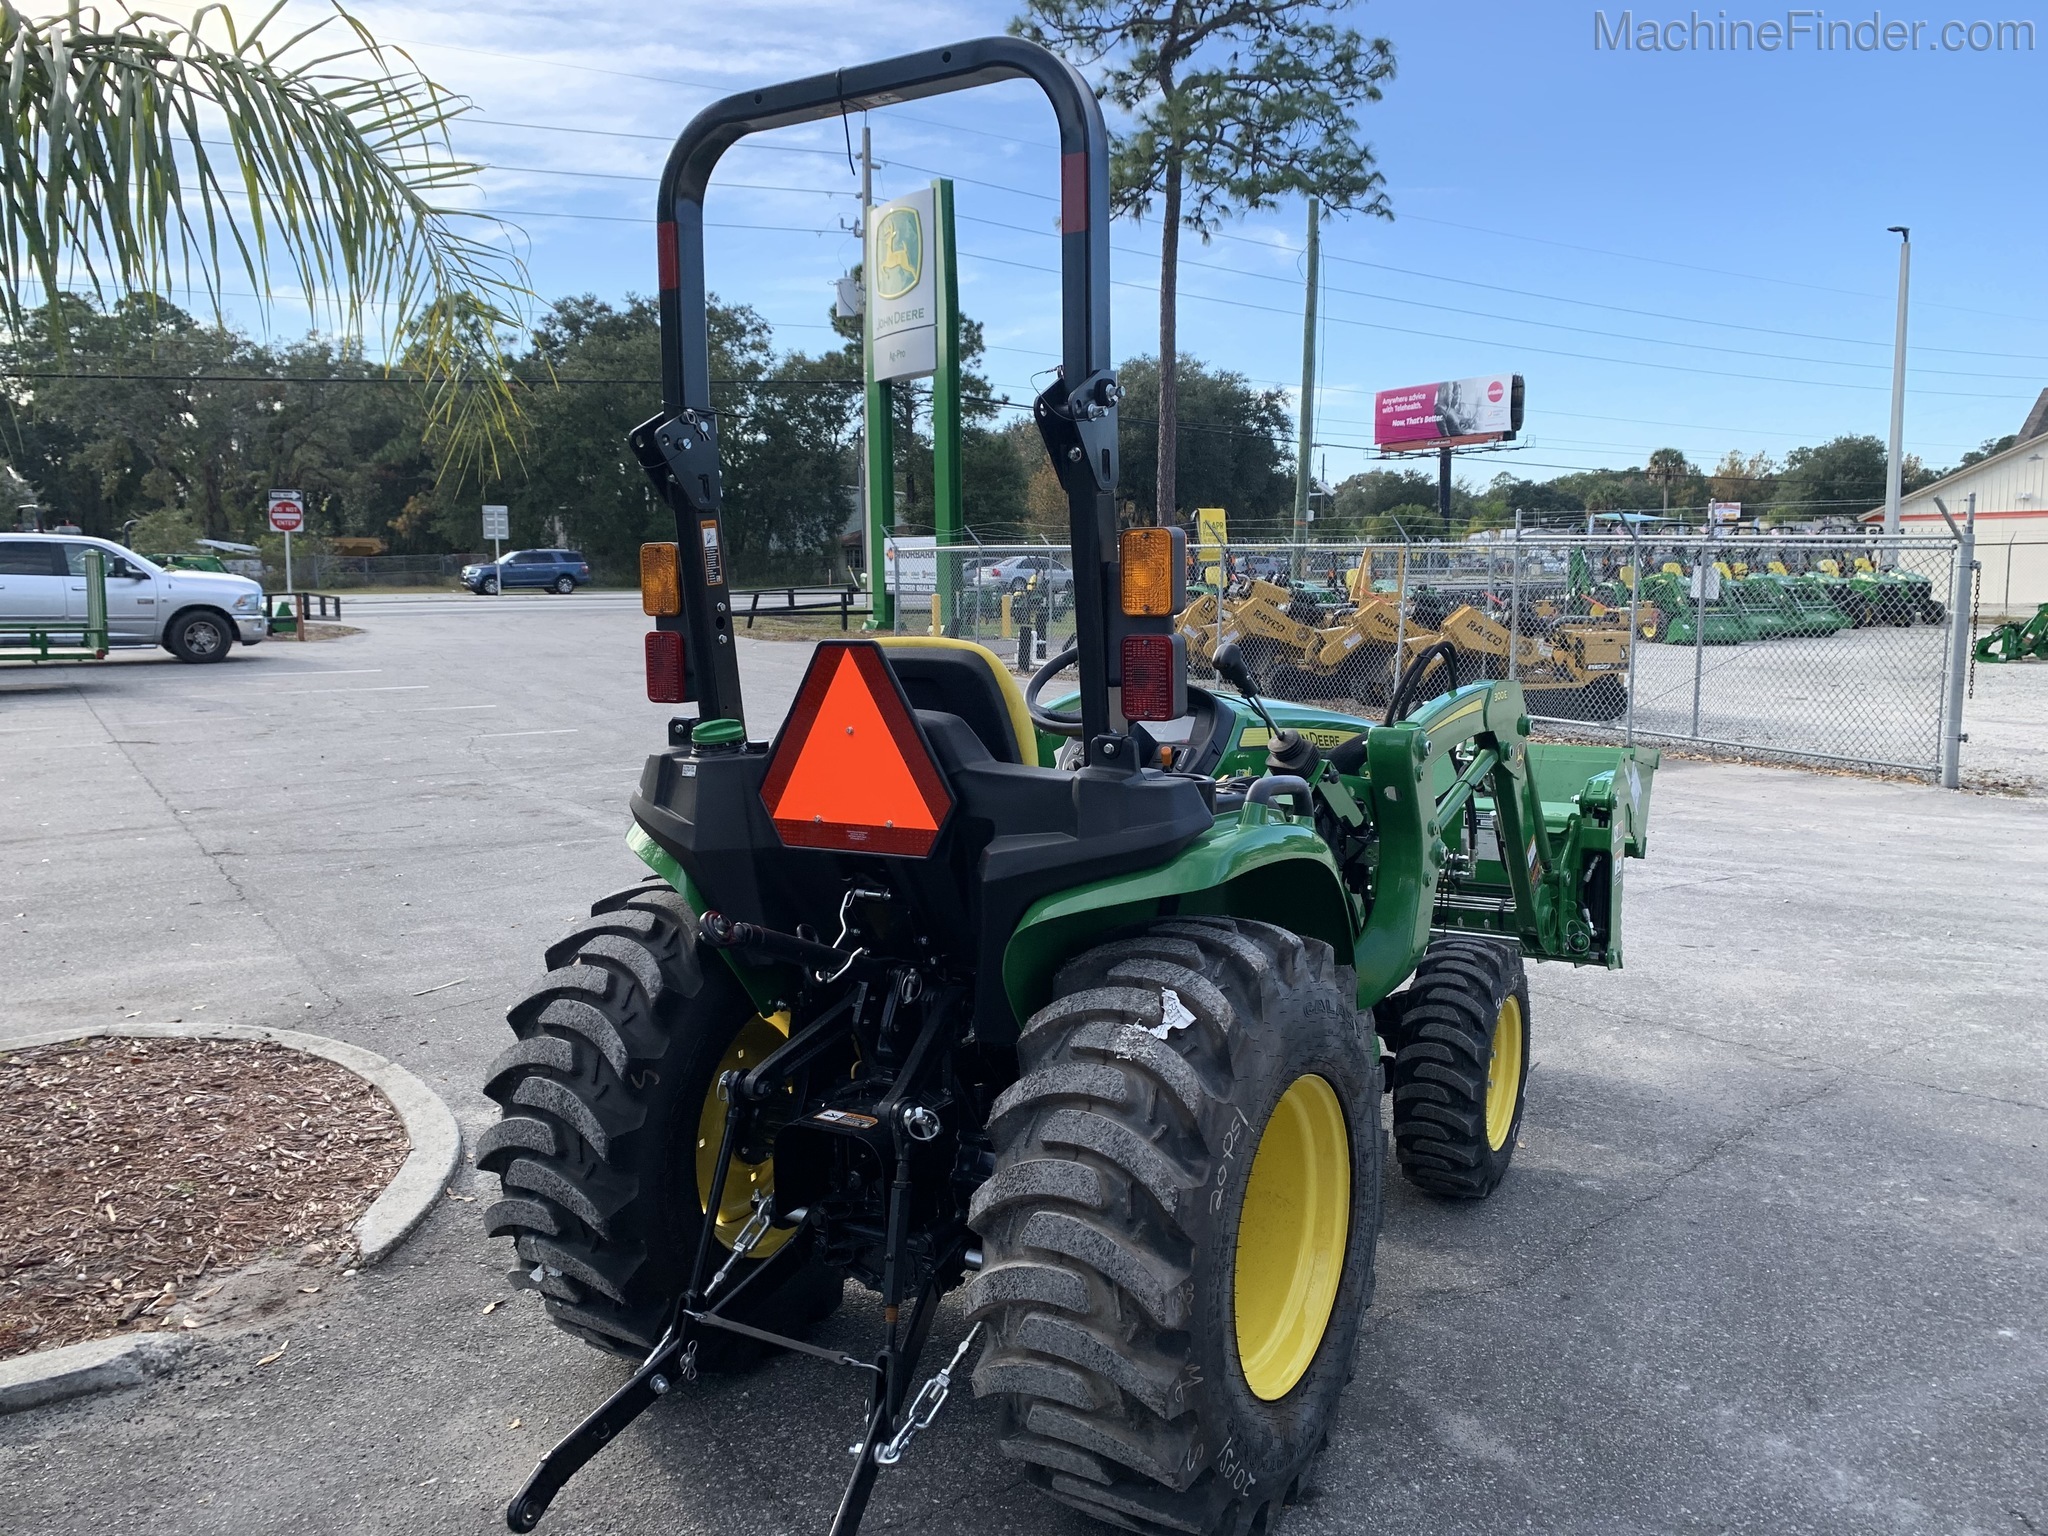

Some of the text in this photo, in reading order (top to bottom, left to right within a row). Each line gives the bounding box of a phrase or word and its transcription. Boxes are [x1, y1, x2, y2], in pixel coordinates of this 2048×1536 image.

[876, 307, 925, 330] JOHN DEERE
[889, 349, 906, 362] Ag-Pro
[1382, 392, 1426, 405] Anywhere advice
[1382, 405, 1394, 413] with
[1406, 416, 1423, 425] That's
[1253, 608, 1286, 633] RAYCO
